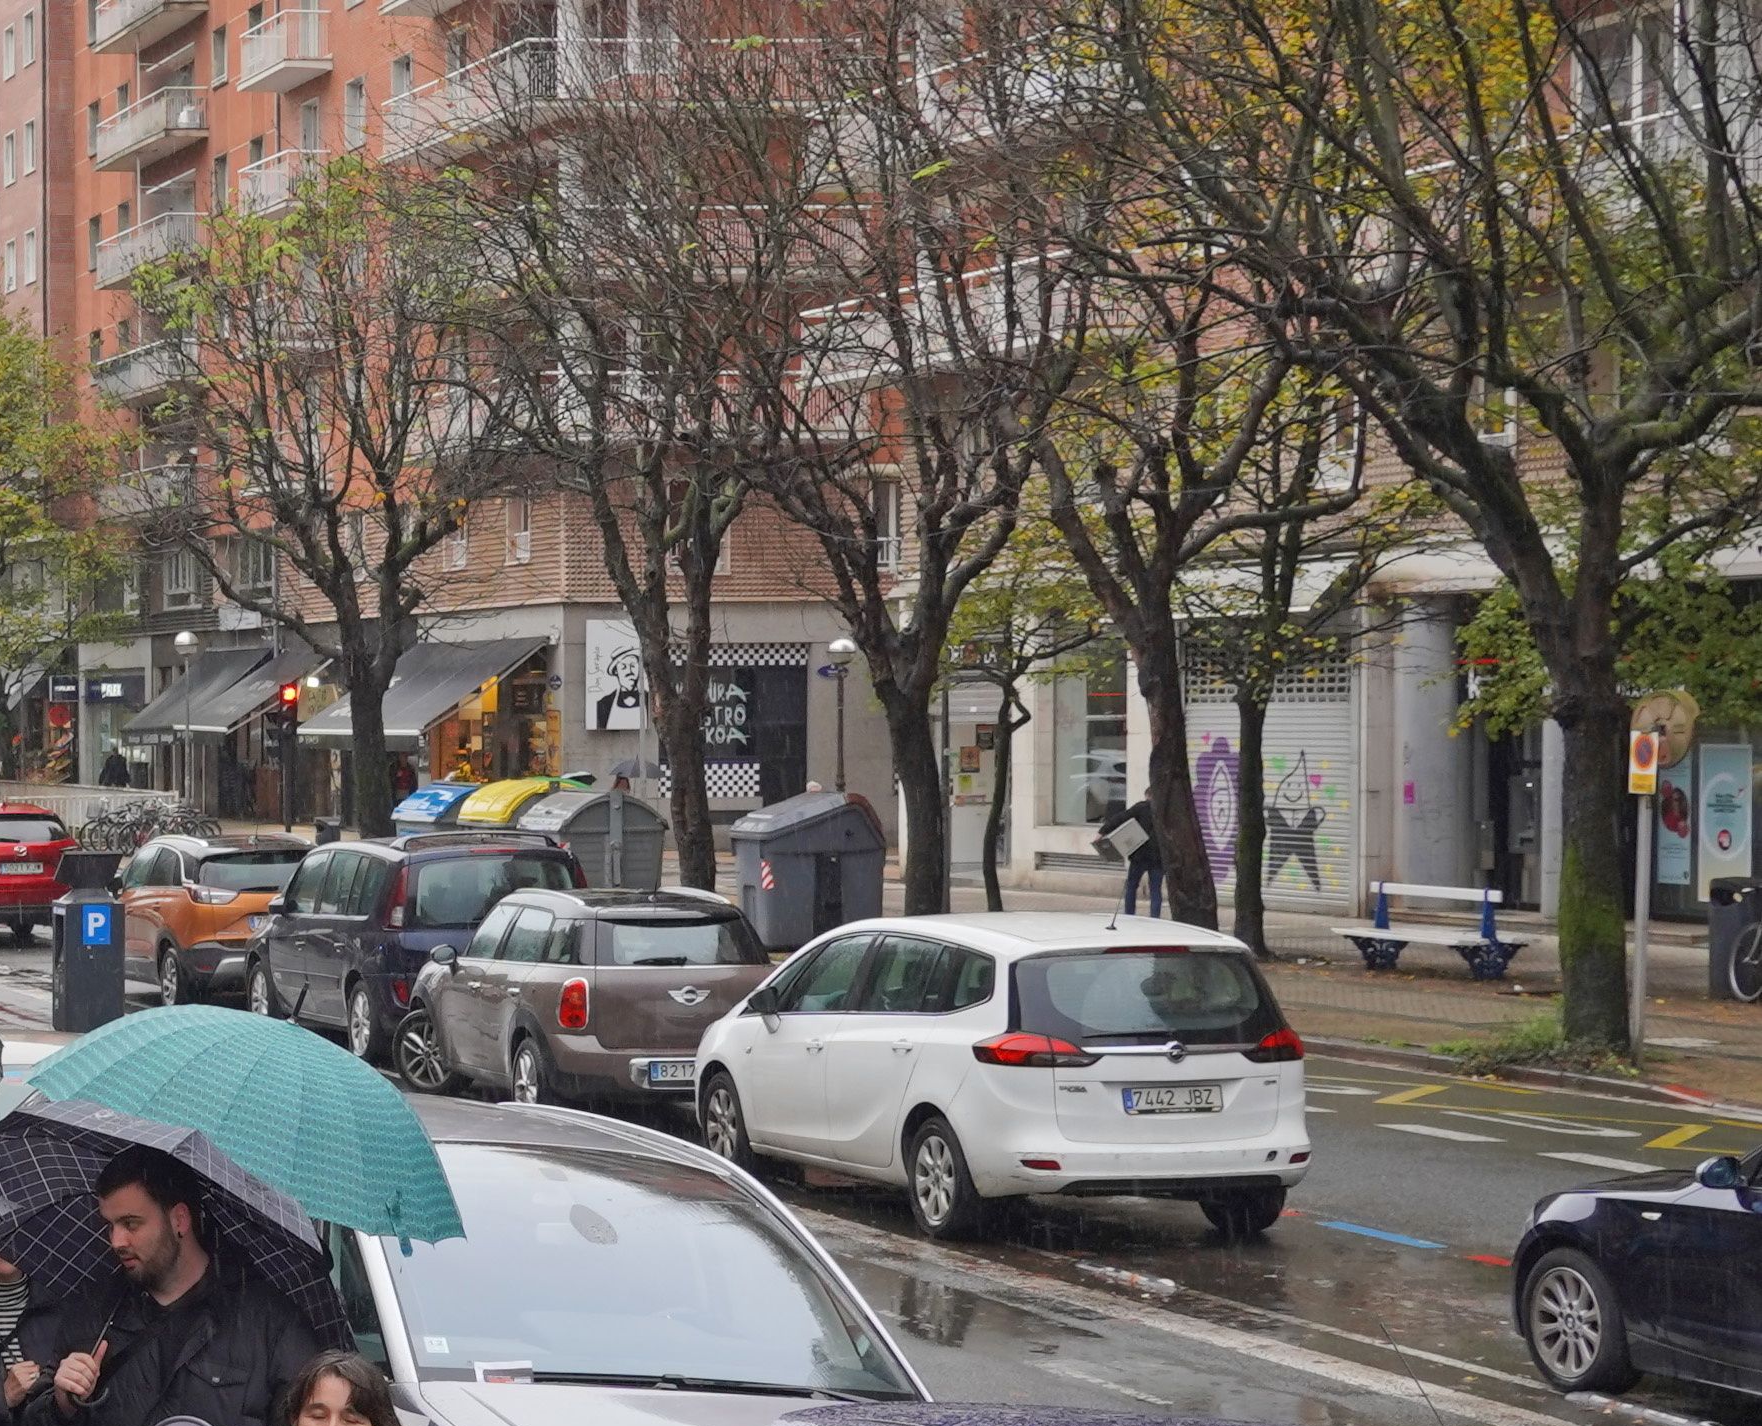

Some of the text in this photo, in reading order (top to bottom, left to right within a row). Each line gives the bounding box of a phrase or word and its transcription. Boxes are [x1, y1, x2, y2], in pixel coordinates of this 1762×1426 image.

[87, 912, 106, 937] P
[1132, 1089, 1215, 1106] 7442 JBZ
